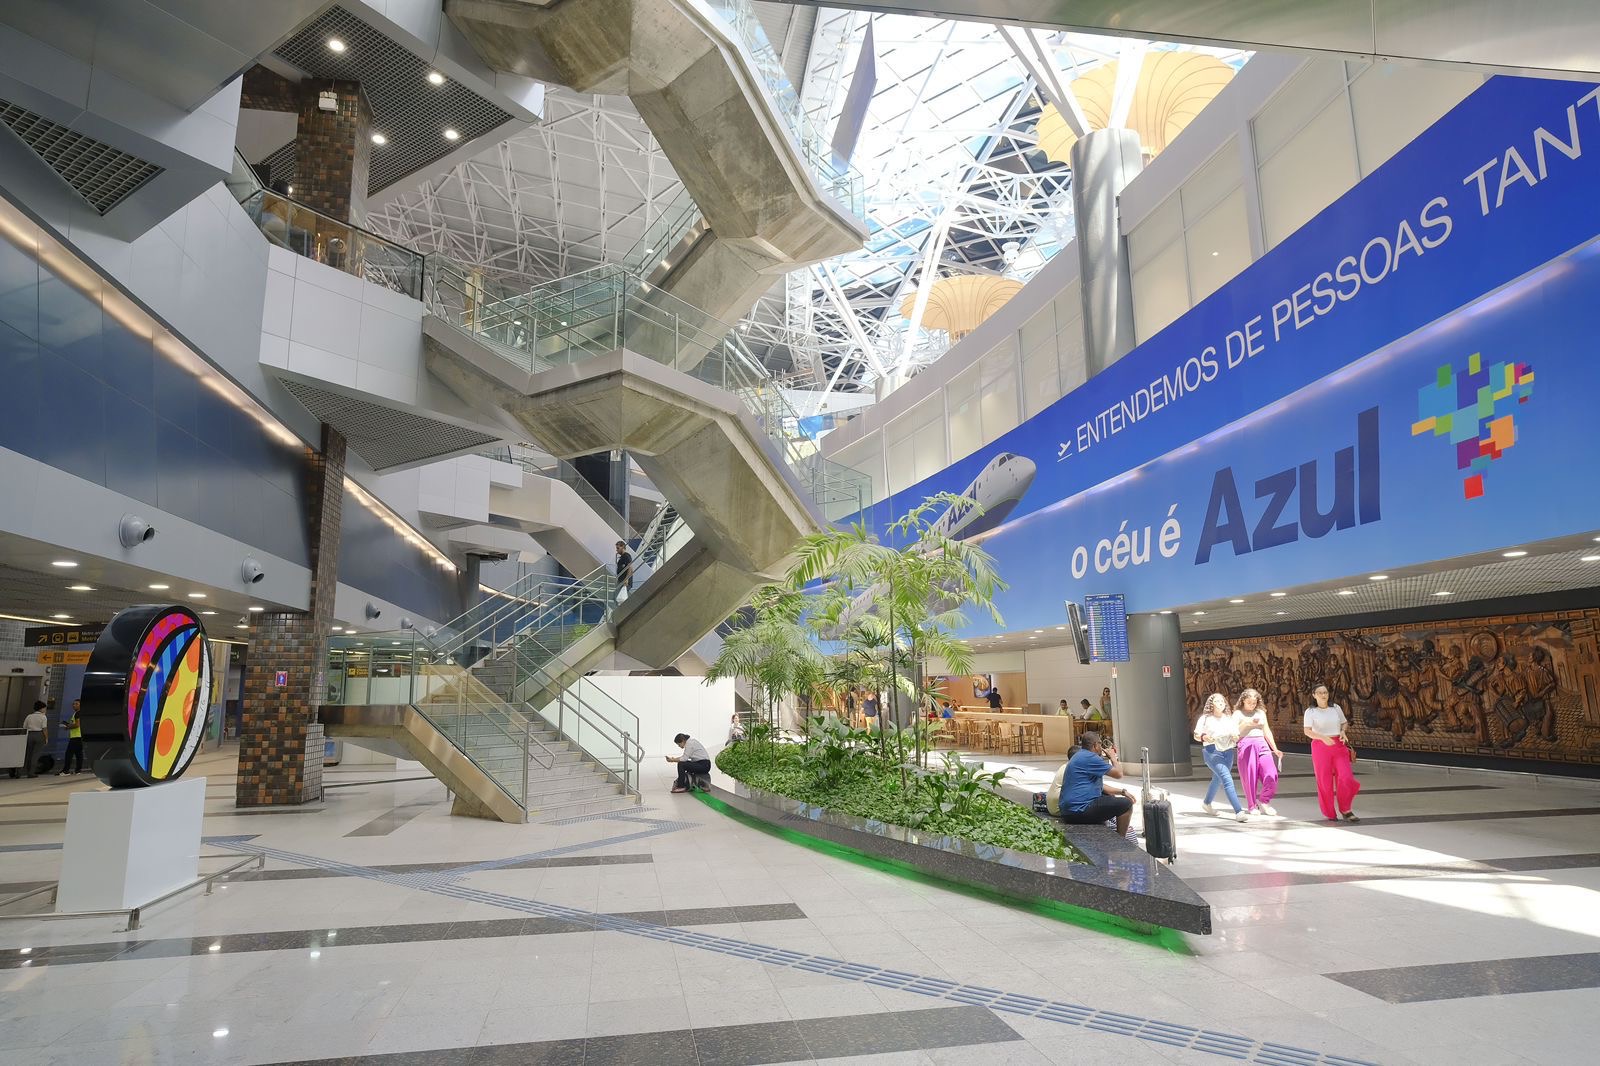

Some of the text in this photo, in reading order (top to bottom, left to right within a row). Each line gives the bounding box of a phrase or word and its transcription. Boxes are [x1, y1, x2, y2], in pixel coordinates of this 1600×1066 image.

[1076, 346, 1219, 453] ENTENDEMOS
[1225, 315, 1265, 369] DE
[1271, 196, 1453, 342] PESSOAS
[1071, 405, 1381, 579] o céu é Azul
